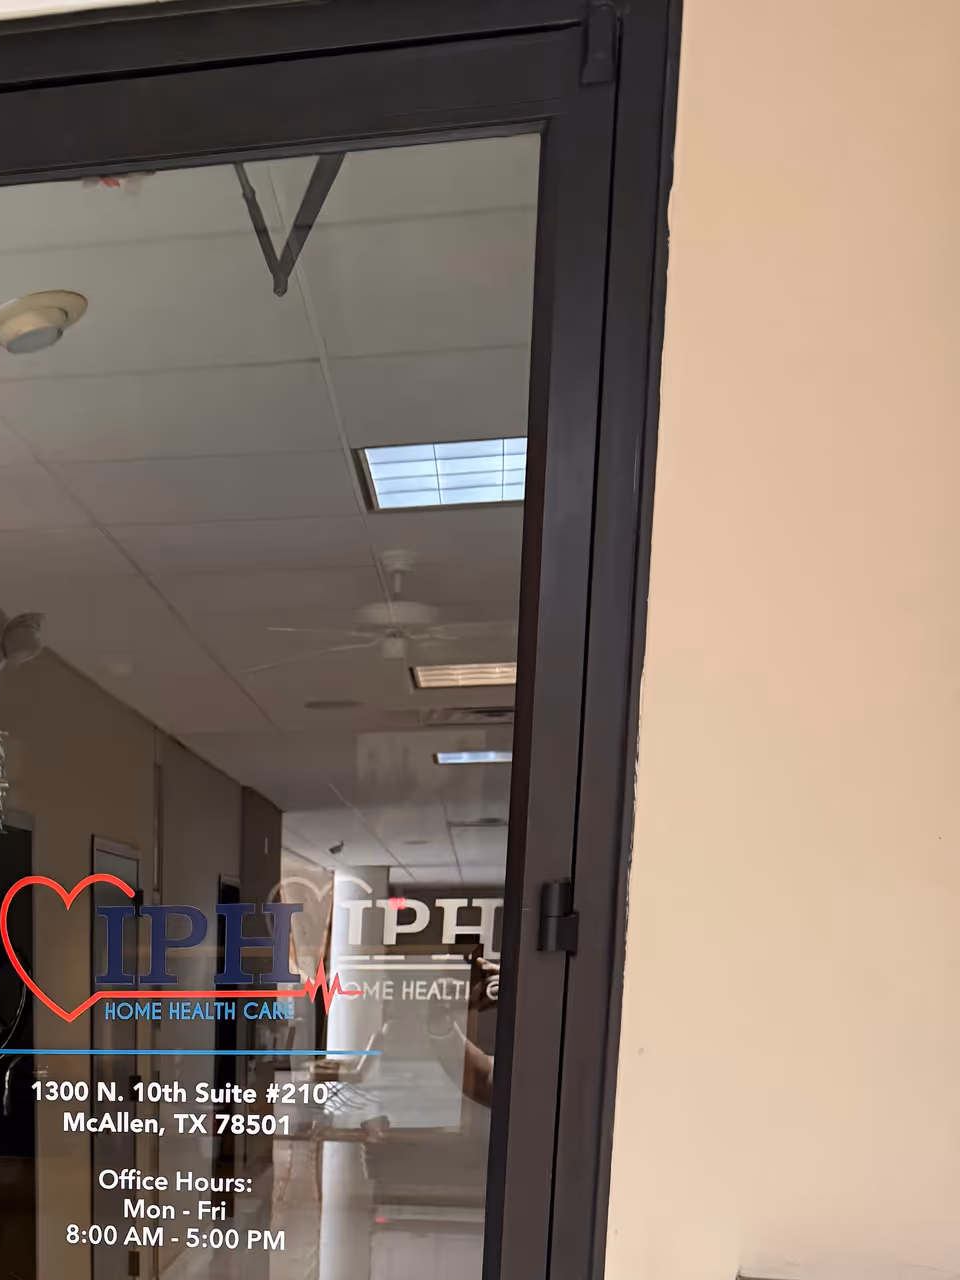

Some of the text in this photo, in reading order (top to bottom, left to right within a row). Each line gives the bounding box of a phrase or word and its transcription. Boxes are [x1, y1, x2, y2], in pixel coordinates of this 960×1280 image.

[95, 903, 304, 984] IPH
[105, 1001, 295, 1020] HOME HEALTH CARE
[31, 1081, 328, 1105] 1300 N. 10th Suite #210
[63, 1112, 290, 1137] McAllen, TX 78501
[98, 1169, 253, 1193] Office Hours:
[124, 1199, 175, 1220] Mon
[198, 1200, 226, 1221] Fri
[66, 1224, 118, 1246] 8:00
[123, 1227, 164, 1247] AM
[185, 1228, 240, 1250] 5:00
[247, 1230, 286, 1251] PM
